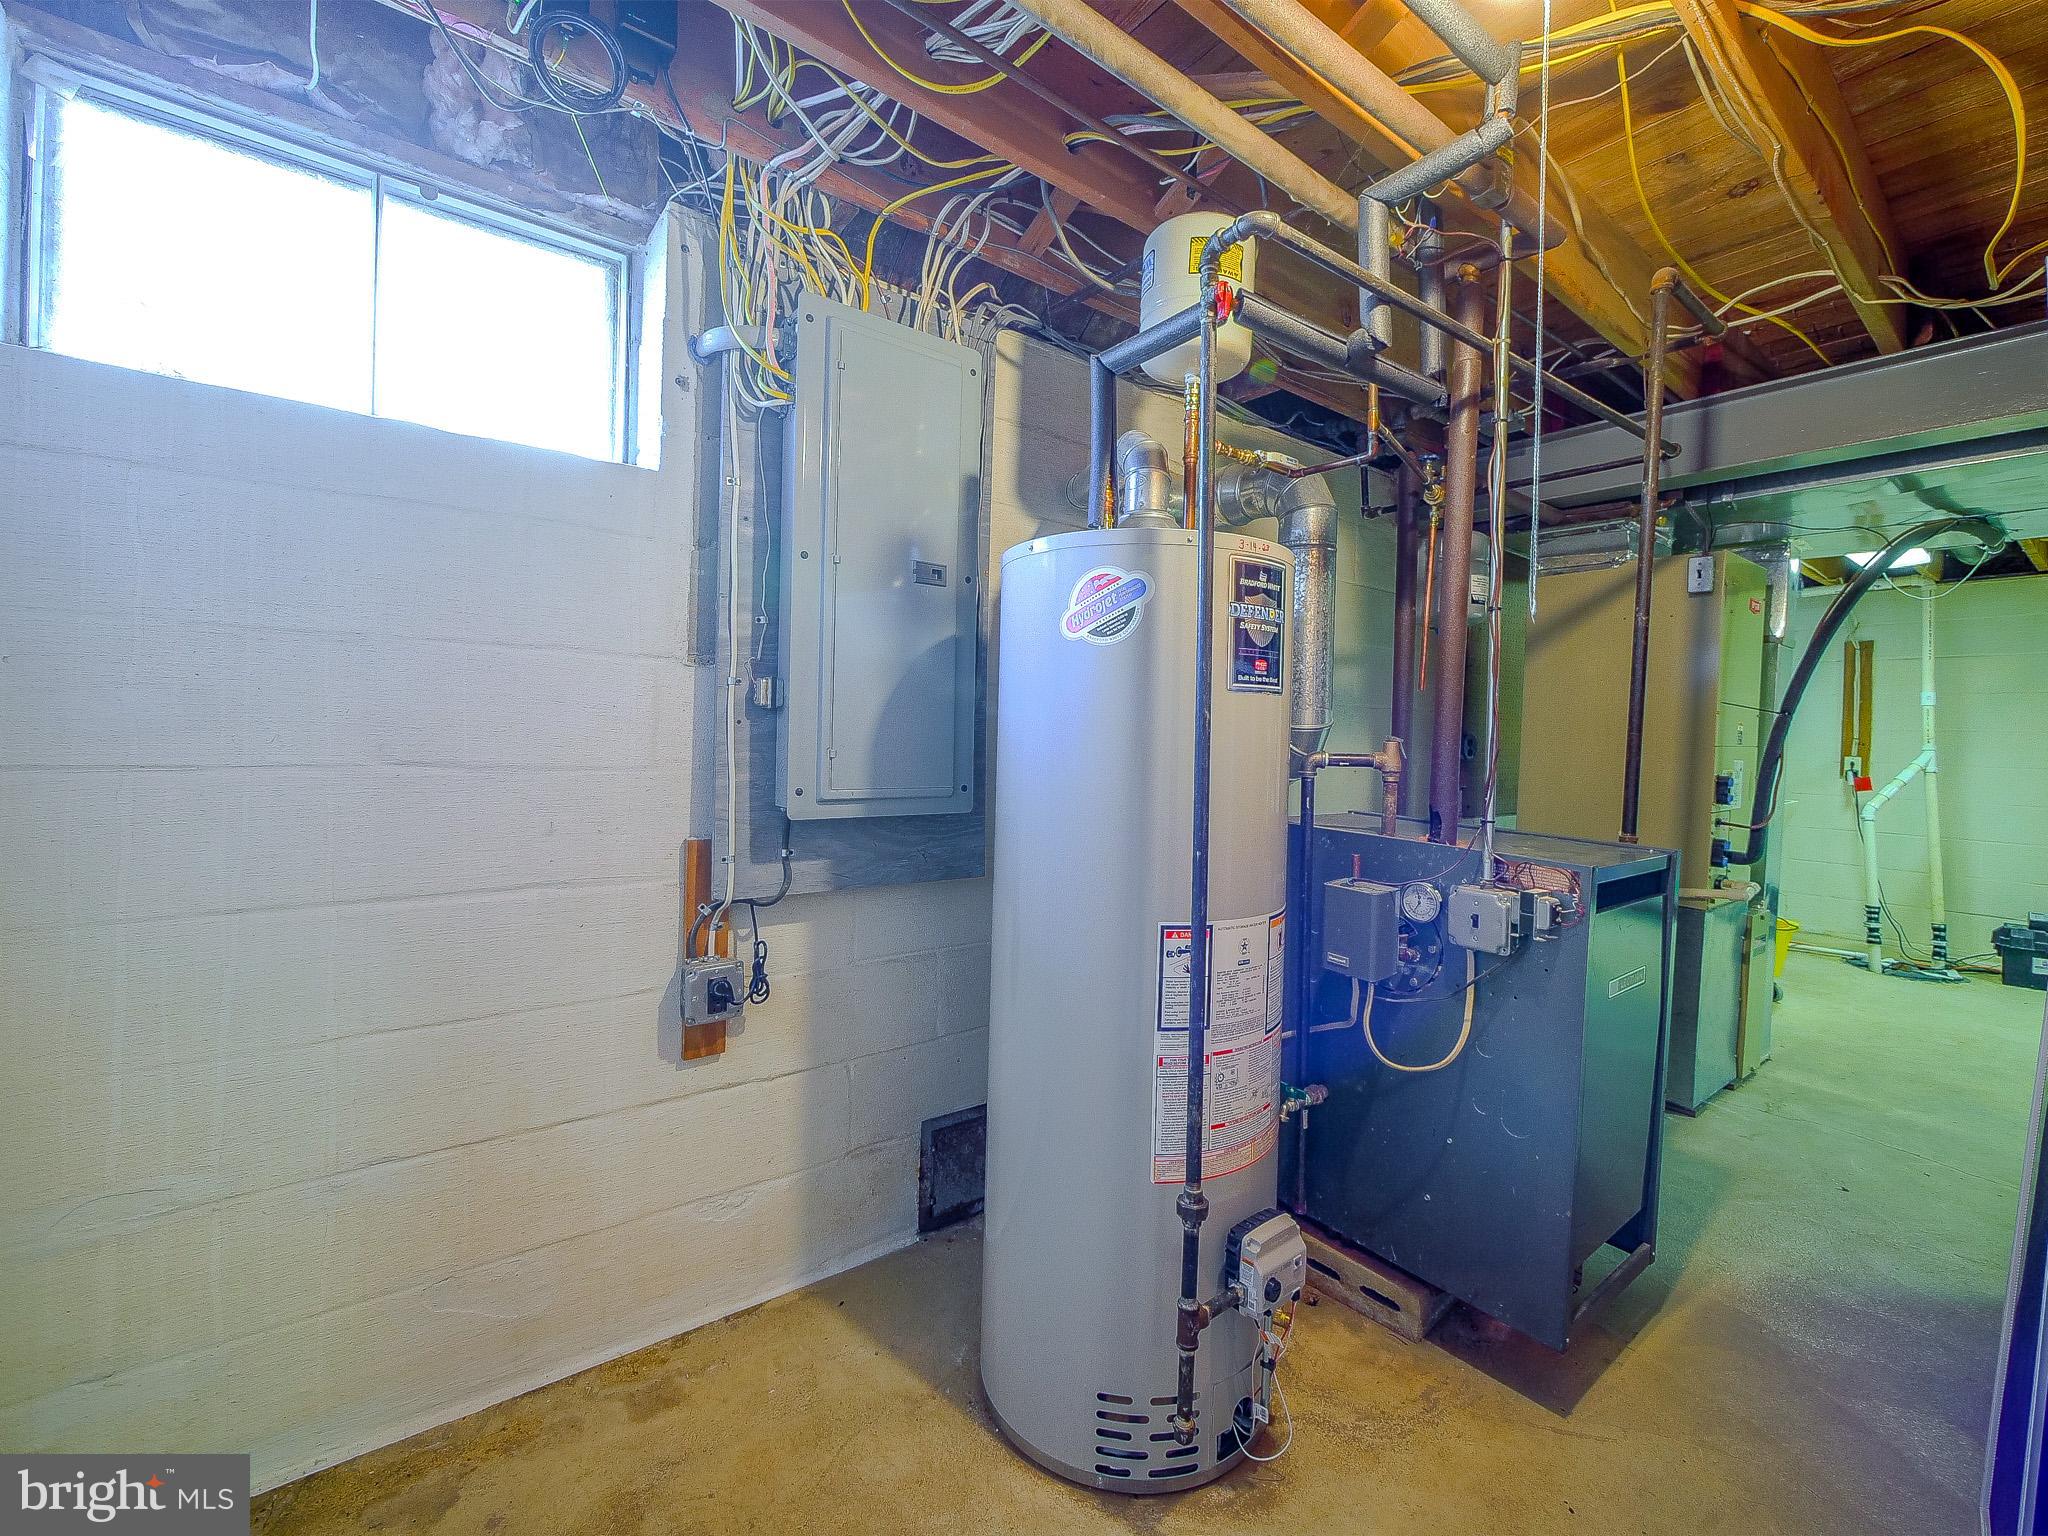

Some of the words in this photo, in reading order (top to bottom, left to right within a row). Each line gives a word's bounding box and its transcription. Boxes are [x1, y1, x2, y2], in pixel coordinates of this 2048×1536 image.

[1240, 577, 1267, 589] BRADFORD
[1230, 602, 1285, 624] DEFENDER
[1240, 621, 1261, 631] SAFETY
